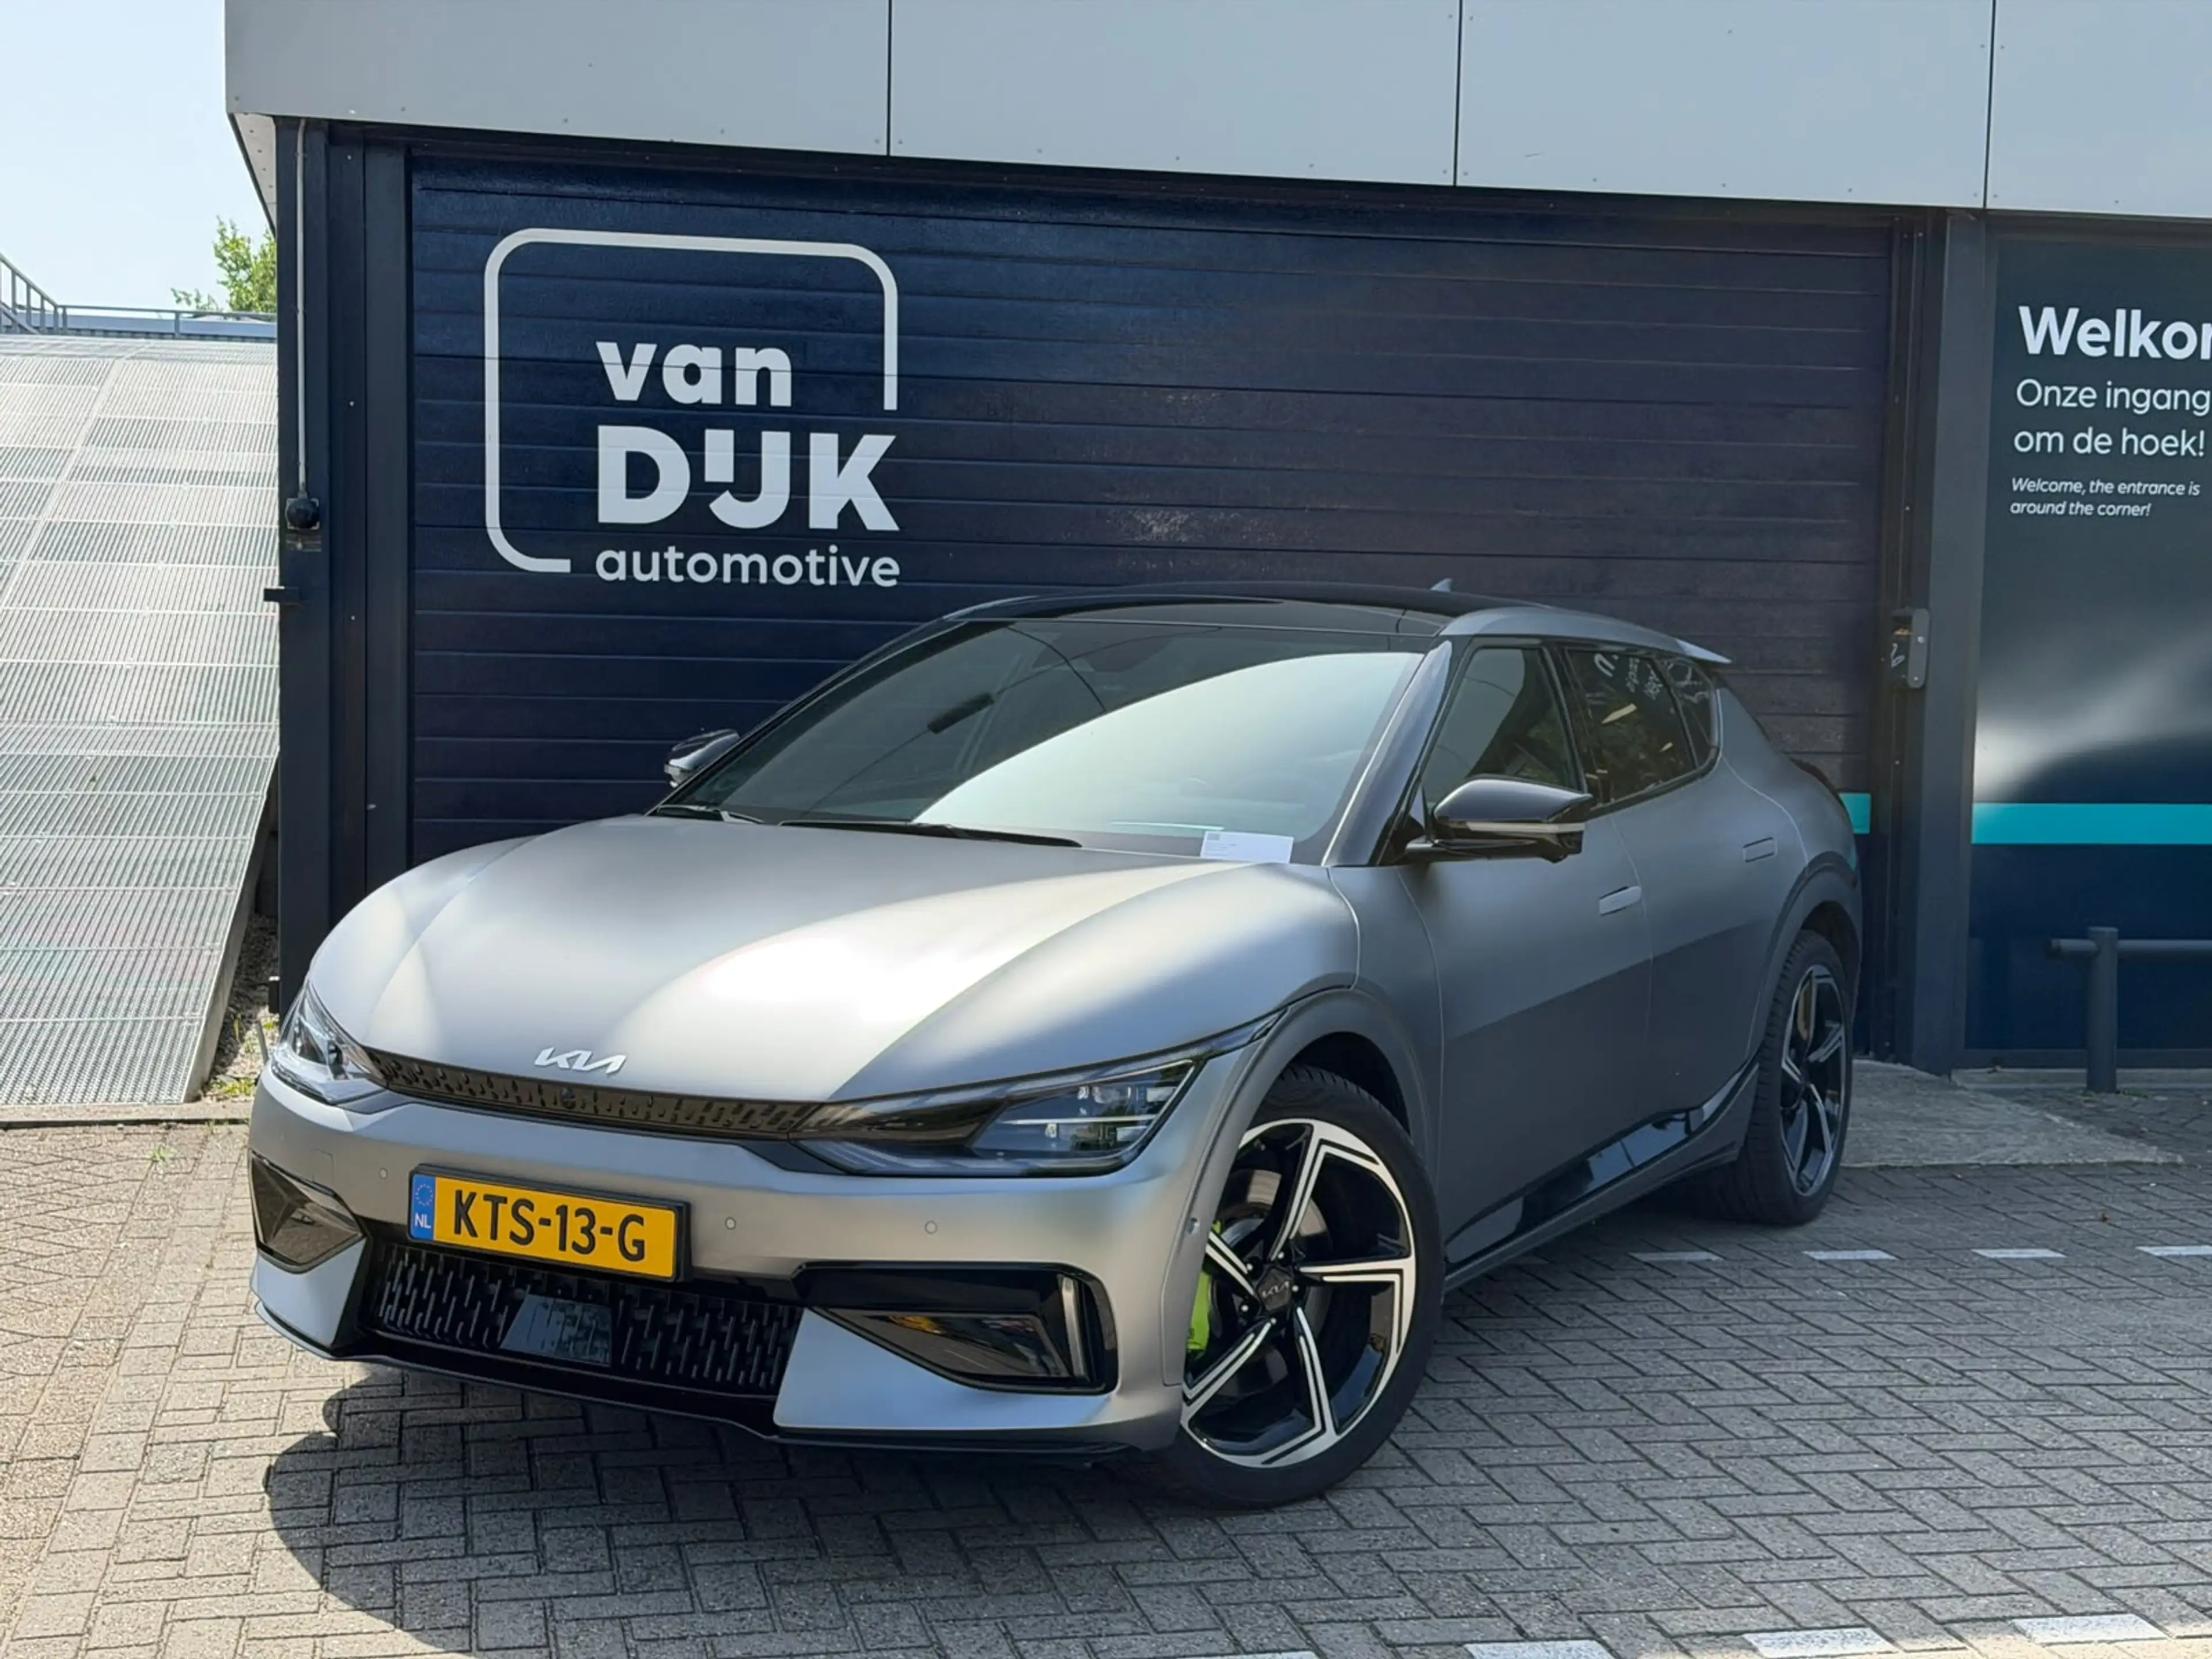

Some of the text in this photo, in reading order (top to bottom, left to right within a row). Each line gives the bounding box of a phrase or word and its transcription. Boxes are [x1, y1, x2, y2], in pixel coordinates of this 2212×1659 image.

[2018, 305, 2212, 360] Welko
[596, 341, 791, 407] van
[2016, 378, 2211, 416] Onze ingang
[2014, 426, 2205, 457] om de hoek!
[597, 425, 899, 531] DIJK
[2012, 477, 2200, 496] Welcome, the entrance is
[2009, 500, 2153, 517] around the corner!
[595, 544, 900, 588] automotive
[533, 1047, 628, 1074] KIA
[414, 1212, 432, 1229] NL
[453, 1188, 646, 1263] KTS-13-G
